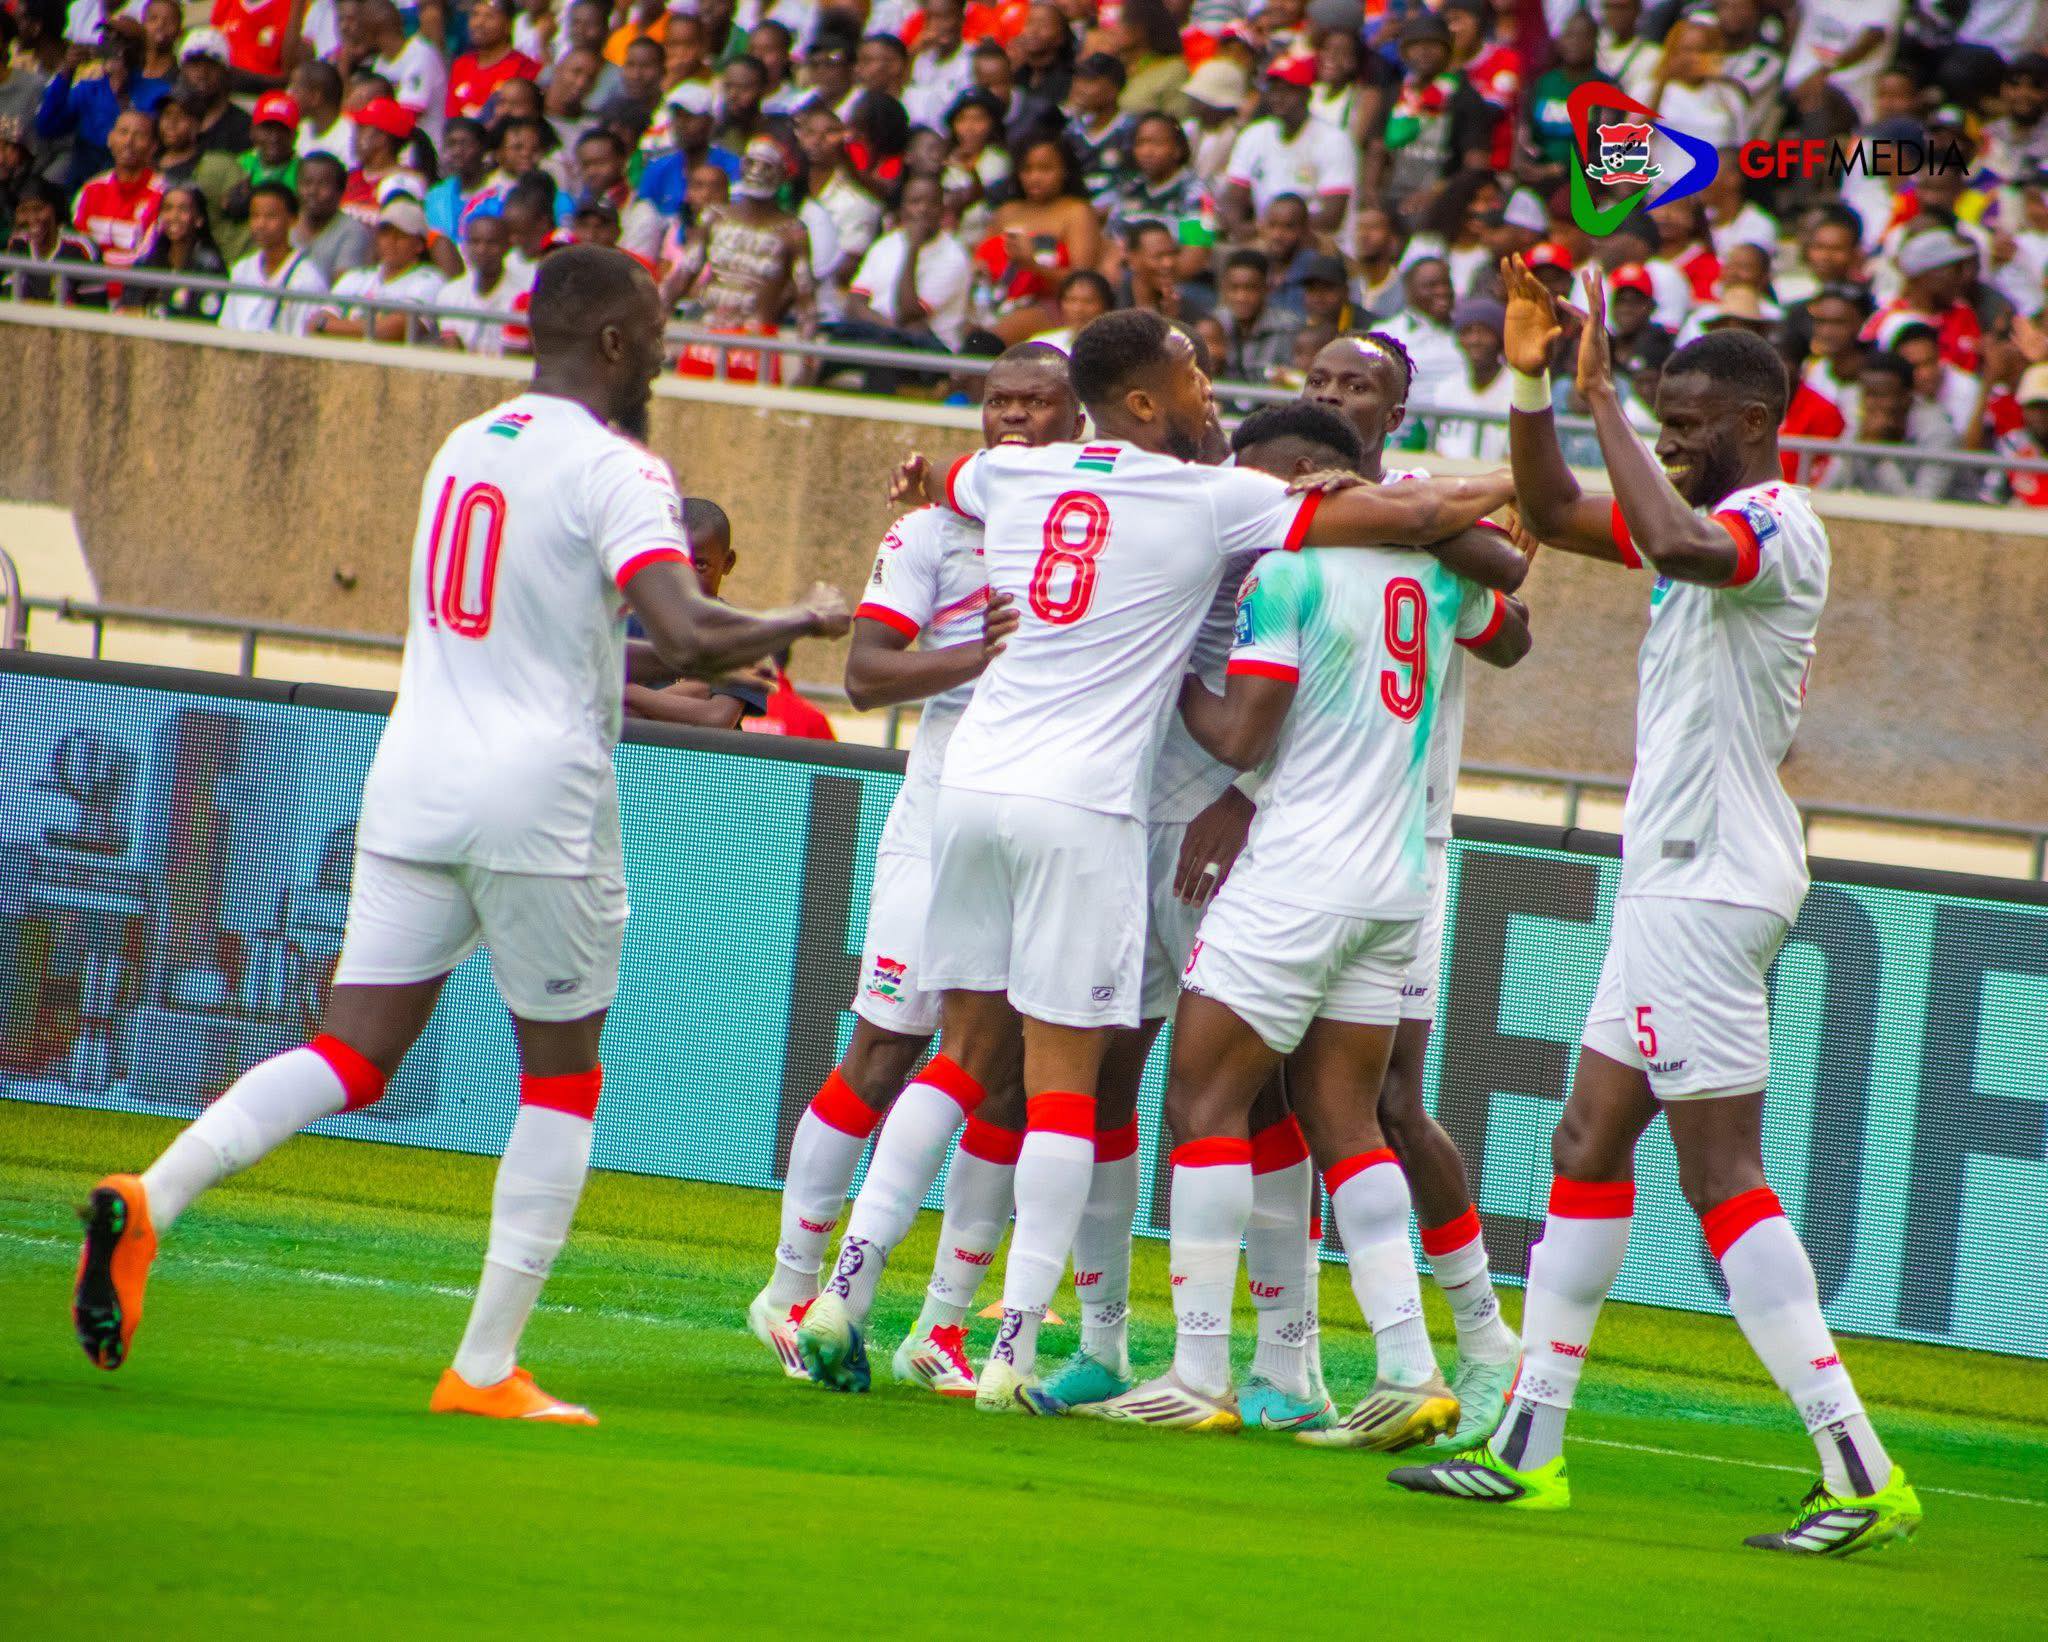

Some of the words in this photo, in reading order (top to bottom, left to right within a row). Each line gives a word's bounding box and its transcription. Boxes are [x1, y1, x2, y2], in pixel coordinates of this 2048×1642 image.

[425, 476, 507, 639] 10
[1029, 490, 1112, 625] 8
[1381, 576, 1428, 722] 9
[1636, 1006, 1657, 1058] 5
